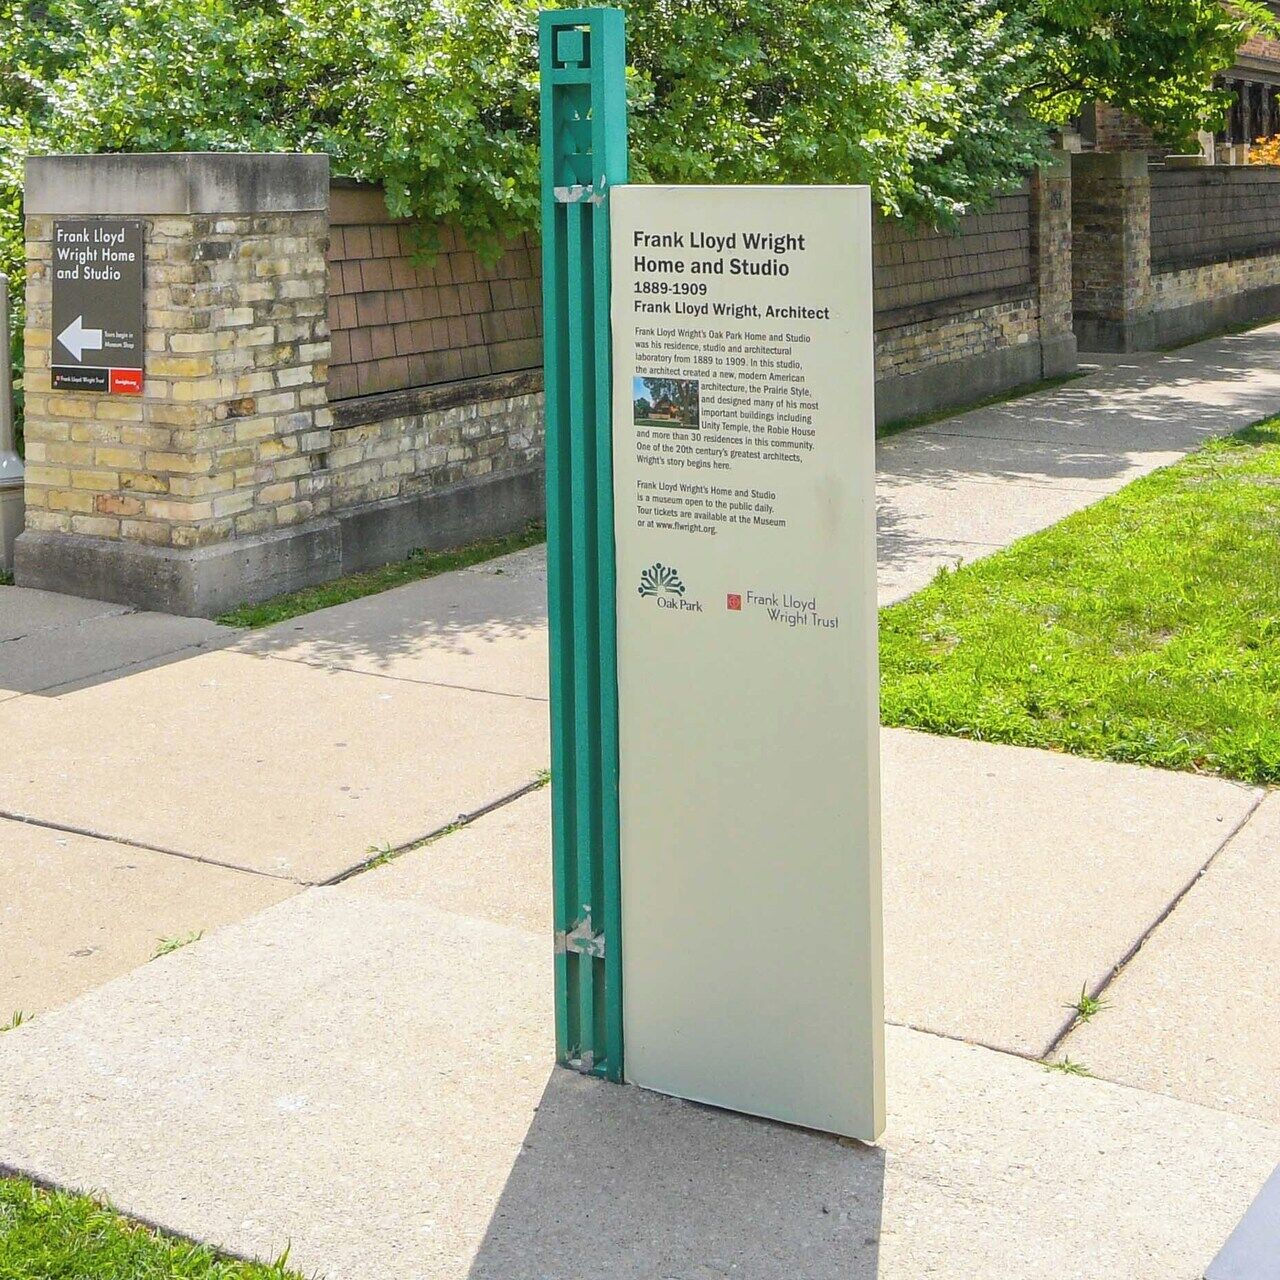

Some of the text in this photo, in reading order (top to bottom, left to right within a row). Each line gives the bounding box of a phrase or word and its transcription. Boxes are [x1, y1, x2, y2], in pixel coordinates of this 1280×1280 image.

[57, 227, 125, 247] Frank Lloyd
[634, 230, 806, 254] Frank Lloyd Wright
[57, 246, 135, 264] Wright Home
[57, 264, 121, 280] and Studio
[634, 255, 789, 277] Home and Studio
[633, 278, 707, 295] 1889-1909
[634, 300, 830, 320] Frank Lloyd Wright, Architect
[635, 326, 811, 343] Frank Lloyd Wright's Oak Park Home and Studio
[634, 340, 792, 356] was his residence, studio and architectural
[635, 352, 802, 370] laboratory from 1889 to 1909. In this studio,
[635, 365, 648, 374] the
[649, 366, 681, 376] architect
[682, 369, 710, 378] created
[719, 371, 737, 380] new,
[738, 371, 767, 380] modern
[768, 372, 805, 383] American
[701, 382, 812, 398] architecture, the Prairie Style,
[701, 395, 819, 410] and designed many of his most
[701, 408, 812, 425] important buildings including
[701, 421, 816, 437] Unity Temple, the Robie House
[636, 430, 815, 452] and more than 30 residences in this community.
[636, 441, 803, 463] One of the 20th century's greatest architects,
[637, 454, 732, 470] Wright's story begins here.
[637, 480, 776, 500] Frank Lloyd Wright's Home and Studio
[637, 492, 644, 502] is
[652, 495, 683, 505] museum
[685, 498, 704, 507] open
[705, 499, 713, 508] to
[715, 499, 727, 509] the
[729, 501, 753, 511] public
[754, 503, 774, 515] daily.
[636, 505, 786, 527] Tour tickets are available at the Museum
[657, 596, 703, 613] Oak Park
[746, 590, 816, 612] Frank Lloyd
[767, 607, 839, 629] Wright Trust
